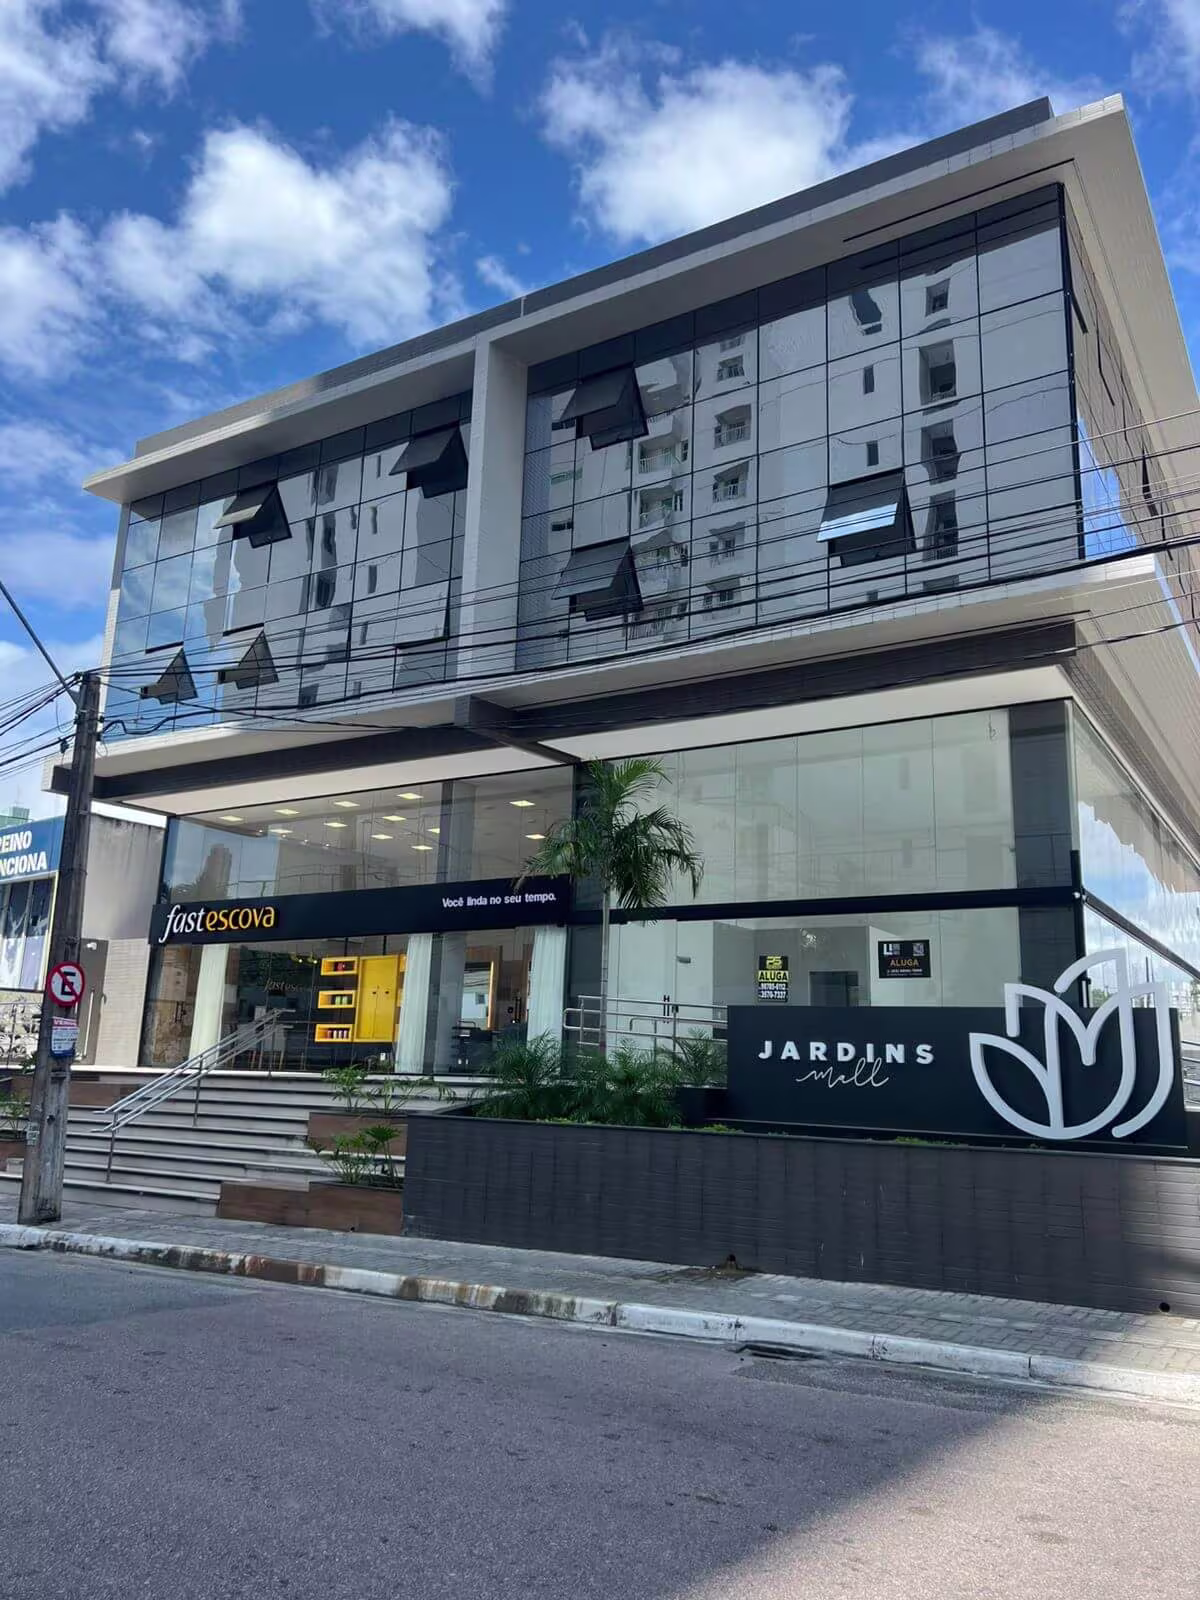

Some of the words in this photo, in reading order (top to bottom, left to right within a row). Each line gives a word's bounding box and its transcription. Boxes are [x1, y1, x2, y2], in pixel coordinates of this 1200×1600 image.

[0, 830, 33, 853] EINO
[442, 897, 464, 908] Você
[466, 896, 488, 907] linda
[490, 896, 502, 905] no
[504, 895, 522, 904] seu
[525, 893, 556, 903] tempo.
[158, 904, 275, 943] fastescova
[889, 959, 920, 967] ALUGA
[61, 971, 77, 996] E
[759, 971, 788, 981] ALUGA
[758, 1040, 934, 1065] JARDINS
